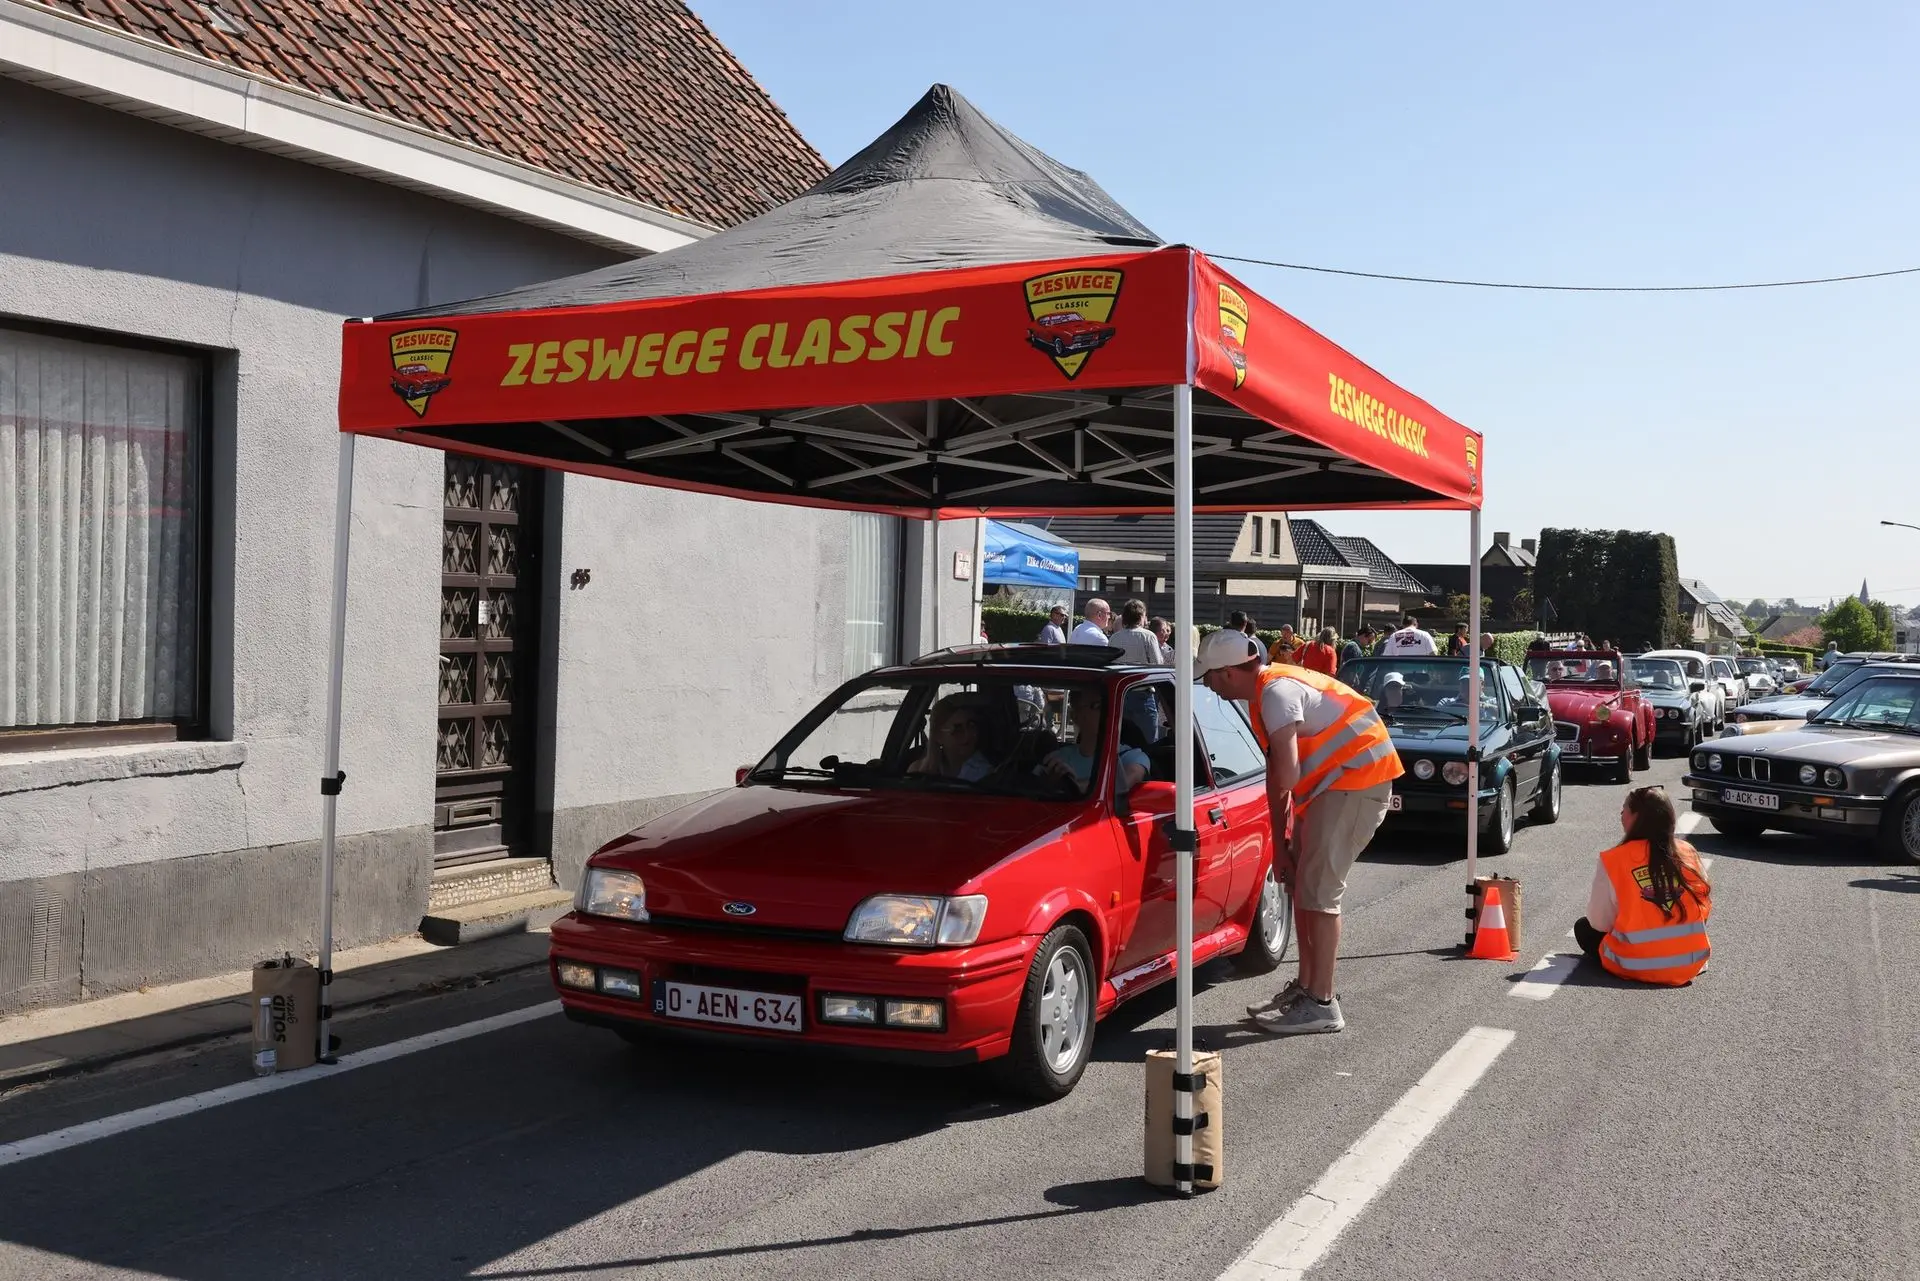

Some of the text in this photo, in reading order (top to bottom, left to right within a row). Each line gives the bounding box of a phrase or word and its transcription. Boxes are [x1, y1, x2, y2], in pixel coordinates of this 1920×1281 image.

[1031, 274, 1115, 297] ZESWEGE
[1055, 301, 1089, 310] CLASSIC
[395, 333, 452, 350] ZESWEGE
[500, 306, 961, 386] ZESWEGE CLASSIC
[409, 354, 434, 362] CLASSIC
[1328, 372, 1430, 459] ZESWEGE CLASSIC
[656, 1000, 664, 1010] B
[273, 994, 286, 1043] SOLID
